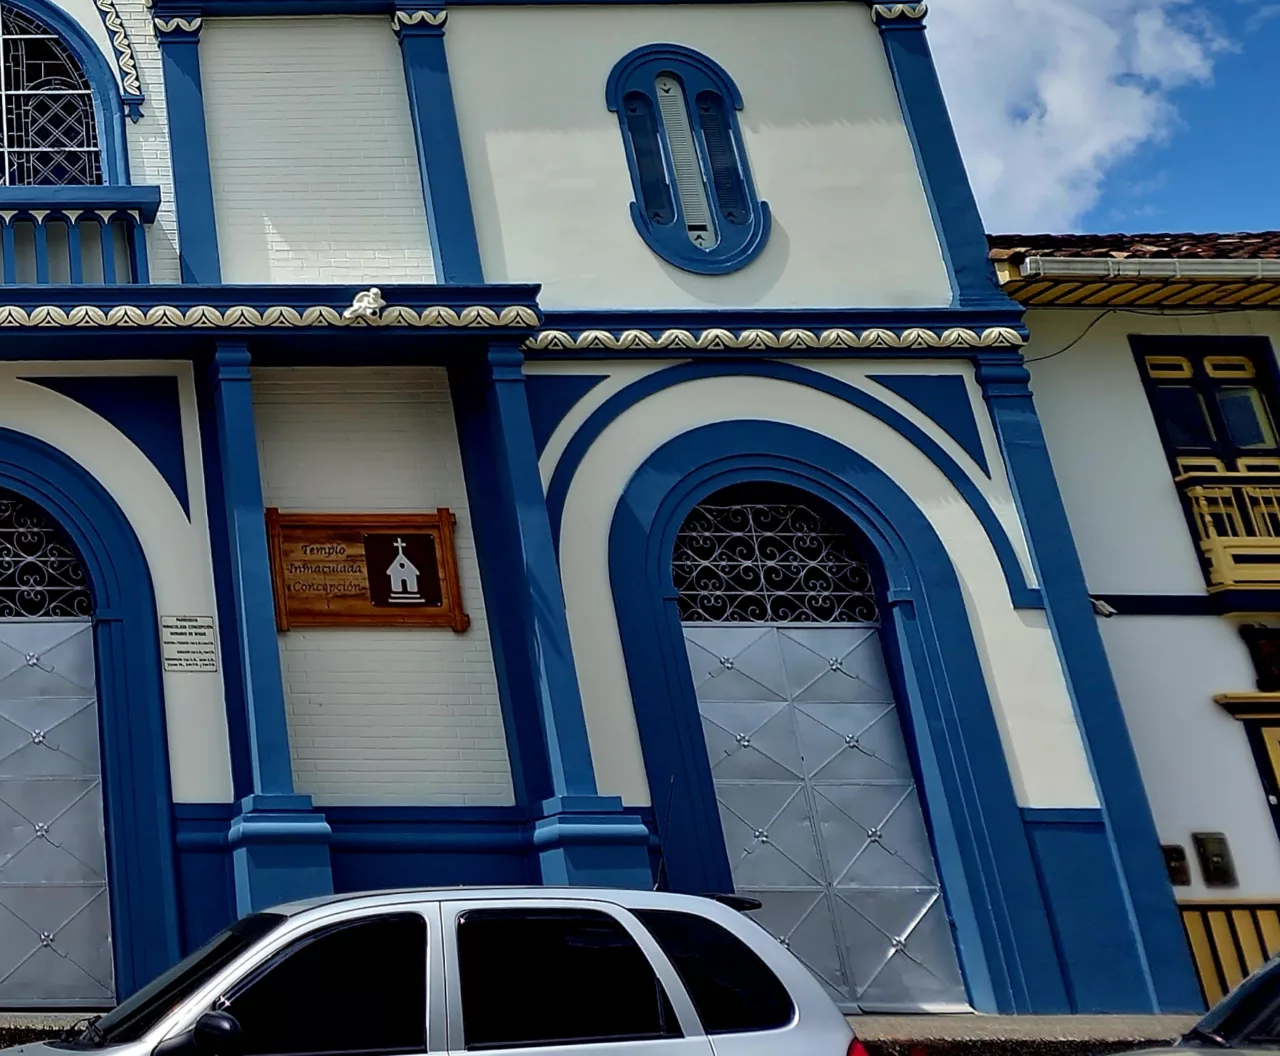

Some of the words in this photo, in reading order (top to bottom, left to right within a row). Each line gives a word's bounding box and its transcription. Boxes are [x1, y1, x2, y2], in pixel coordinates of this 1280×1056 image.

[301, 543, 347, 558] Templo
[289, 562, 363, 574] Inmaculada
[293, 580, 362, 593] Concepción
